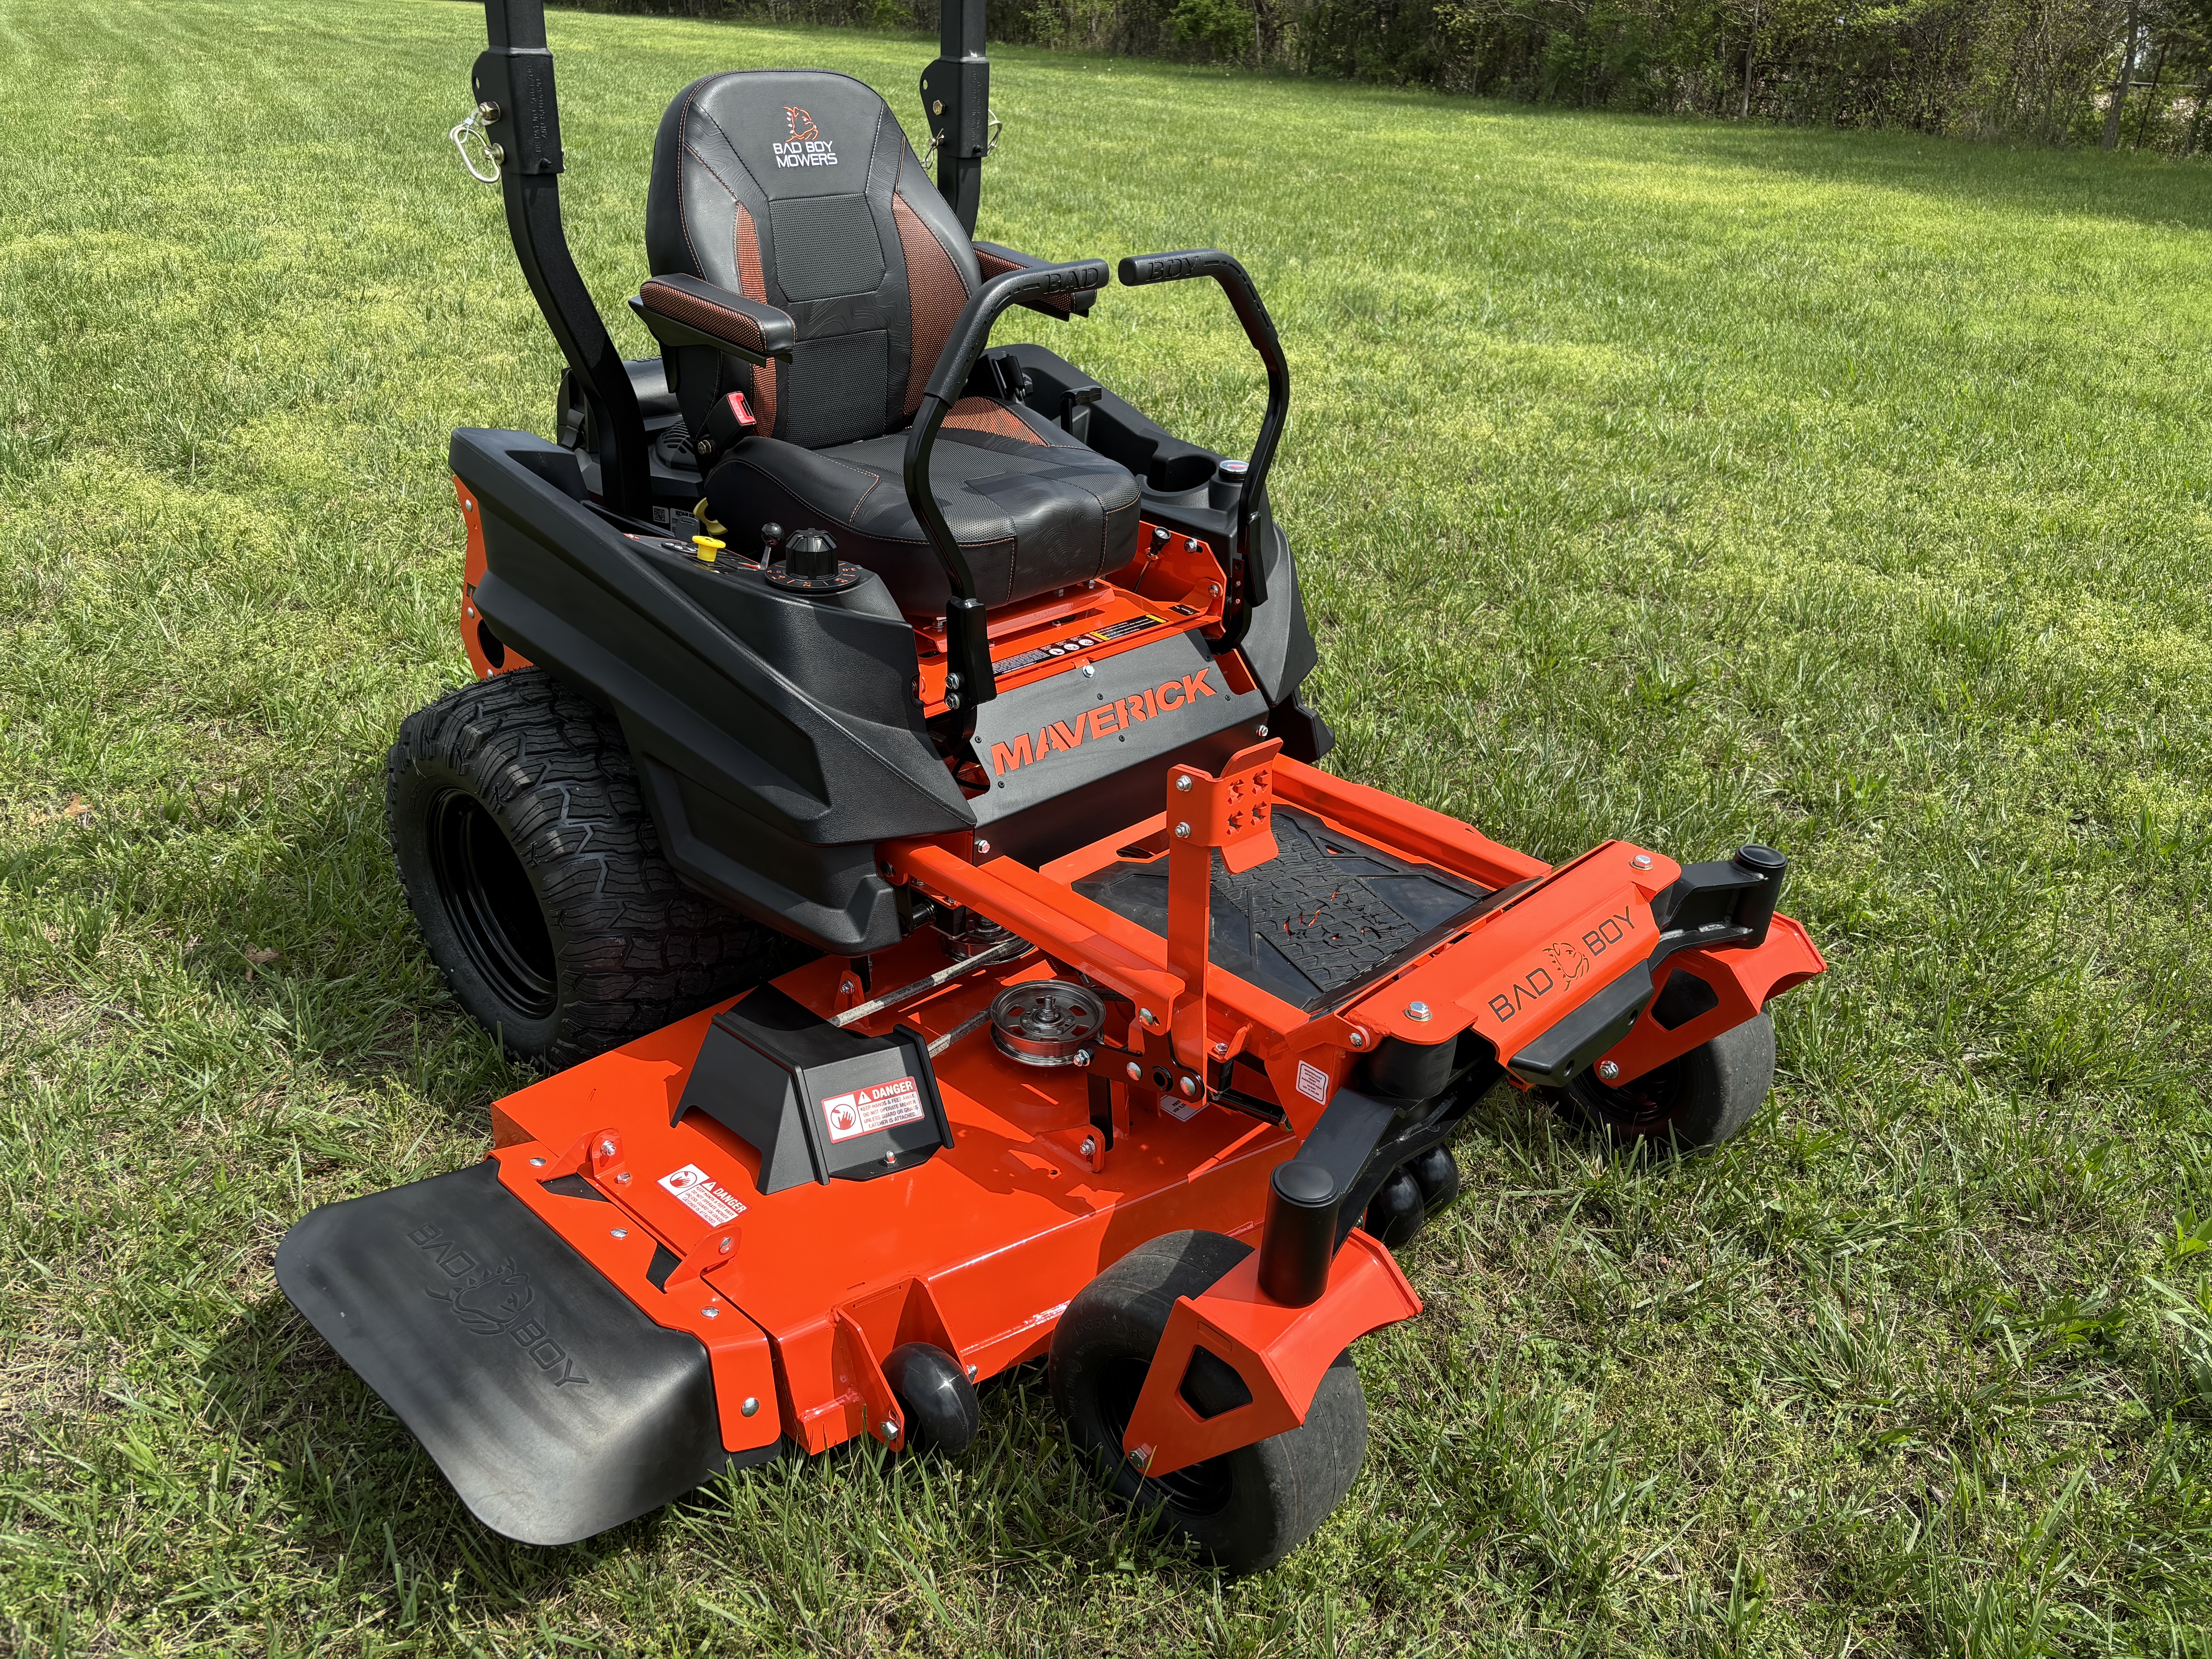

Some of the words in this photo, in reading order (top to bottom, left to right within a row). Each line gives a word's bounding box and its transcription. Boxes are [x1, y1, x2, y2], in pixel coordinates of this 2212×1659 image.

[773, 142, 802, 155] BAD
[805, 141, 833, 153] BOY
[776, 153, 838, 168] MOWERS
[1044, 267, 1099, 294] BAD
[1146, 256, 1200, 282] BOY
[990, 667, 1217, 776] MAVERICK
[1488, 967, 1554, 1022] BAD
[1582, 905, 1637, 957] BOY
[872, 1080, 913, 1099] DANGER
[869, 1120, 888, 1128] CATCHER
[894, 1112, 917, 1121] ATTACHED.
[682, 1197, 696, 1208] CATCHER
[685, 1192, 698, 1202] UNLESS
[697, 1202, 709, 1210] GUARD
[712, 1214, 724, 1222] GRASS
[703, 1192, 715, 1200] HANDS
[713, 1188, 747, 1213] DANGER
[702, 1199, 716, 1209] OPERATE
[715, 1209, 729, 1219] MOWER
[407, 1221, 476, 1278] BAD
[509, 1318, 590, 1387] BOY
